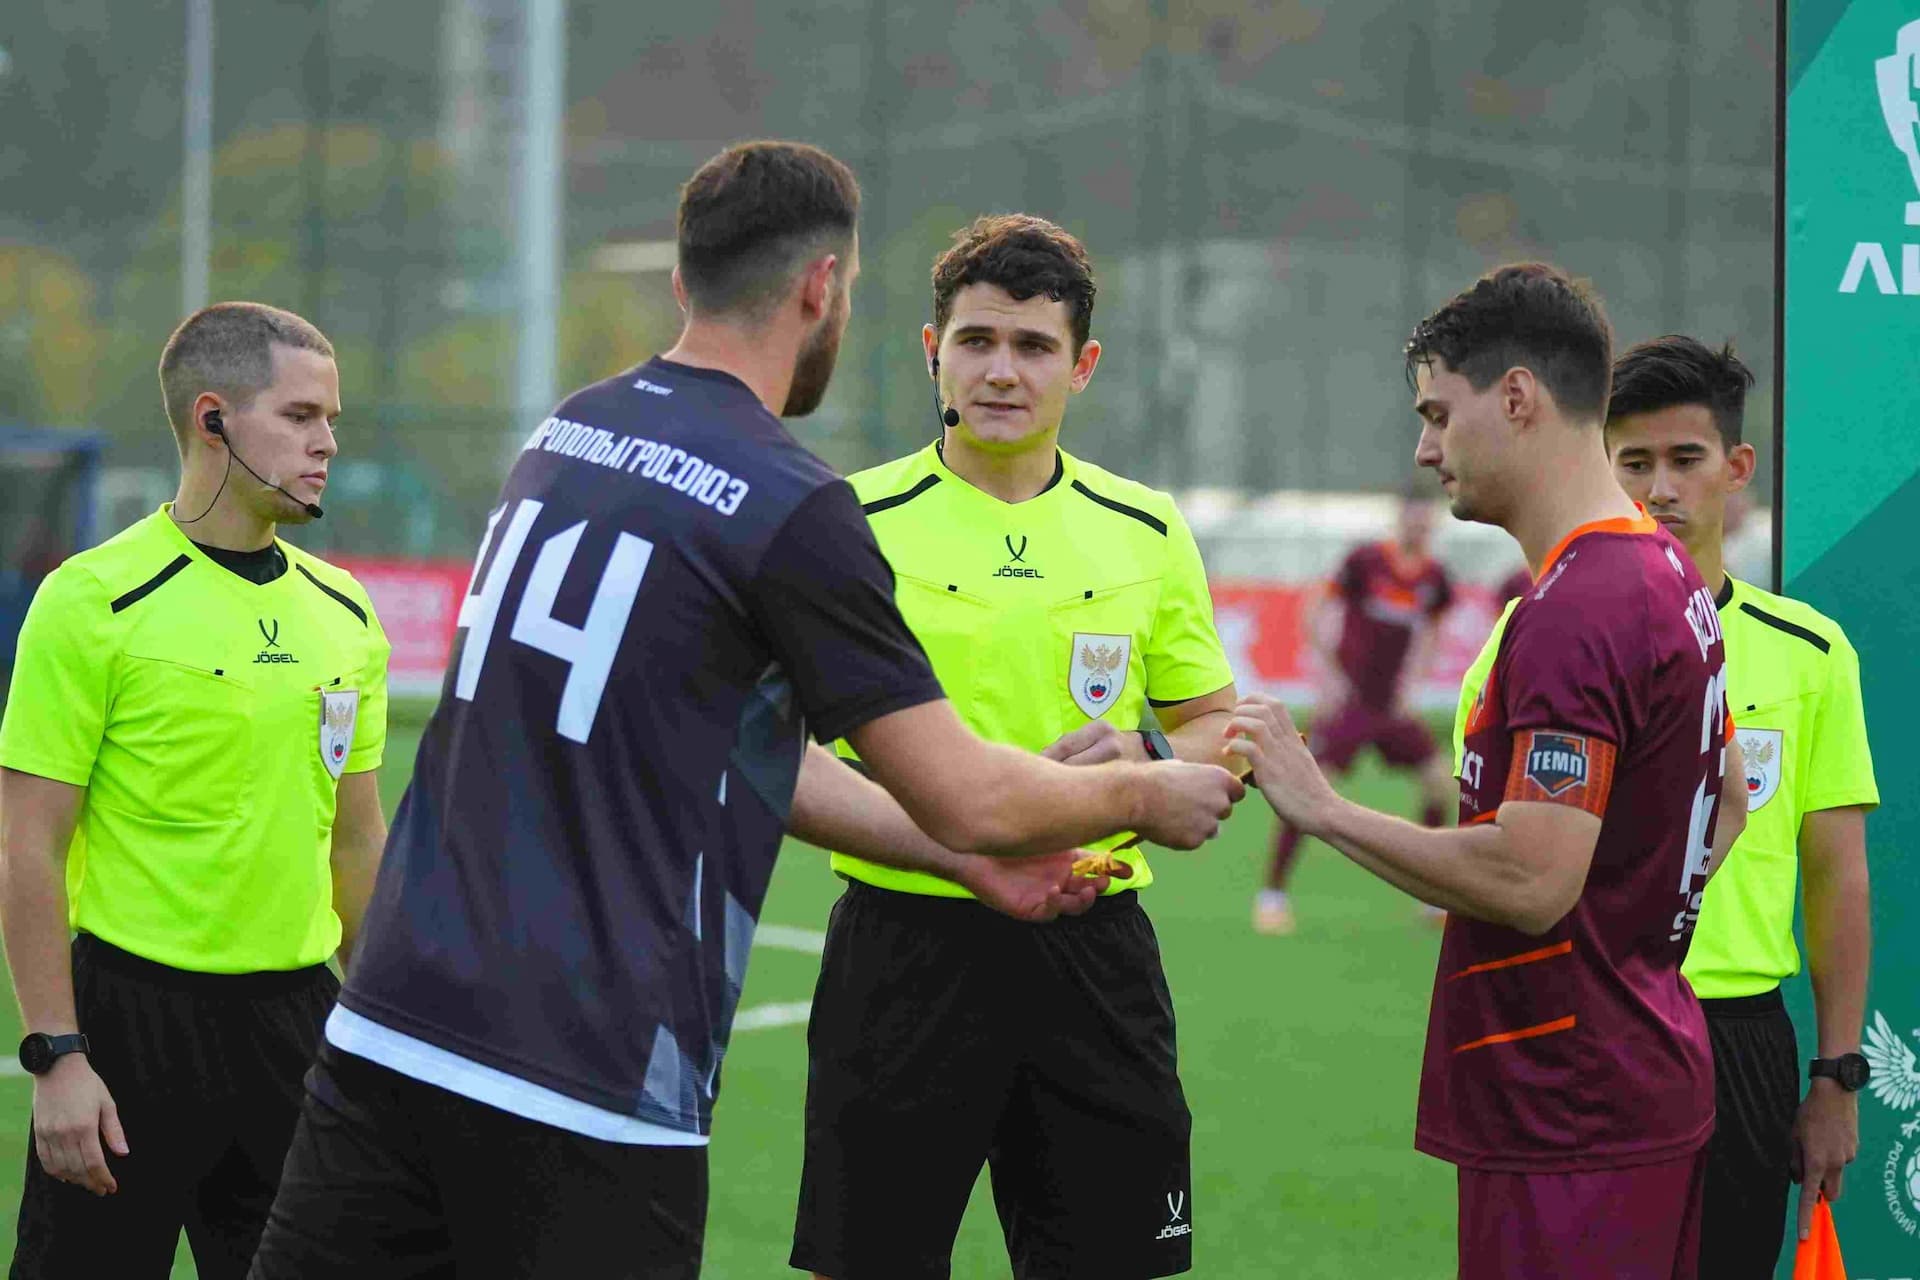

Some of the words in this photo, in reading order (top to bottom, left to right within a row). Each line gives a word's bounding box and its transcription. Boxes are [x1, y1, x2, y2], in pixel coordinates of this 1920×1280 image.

[992, 566, 1044, 578] JÖGEL
[455, 498, 654, 745] 44
[252, 651, 299, 663] JÖGEL
[1532, 750, 1583, 778] ТЕМП
[1884, 1140, 1917, 1235] РОССИЙСКИЙ
[1156, 1223, 1192, 1239] JÖGEL
